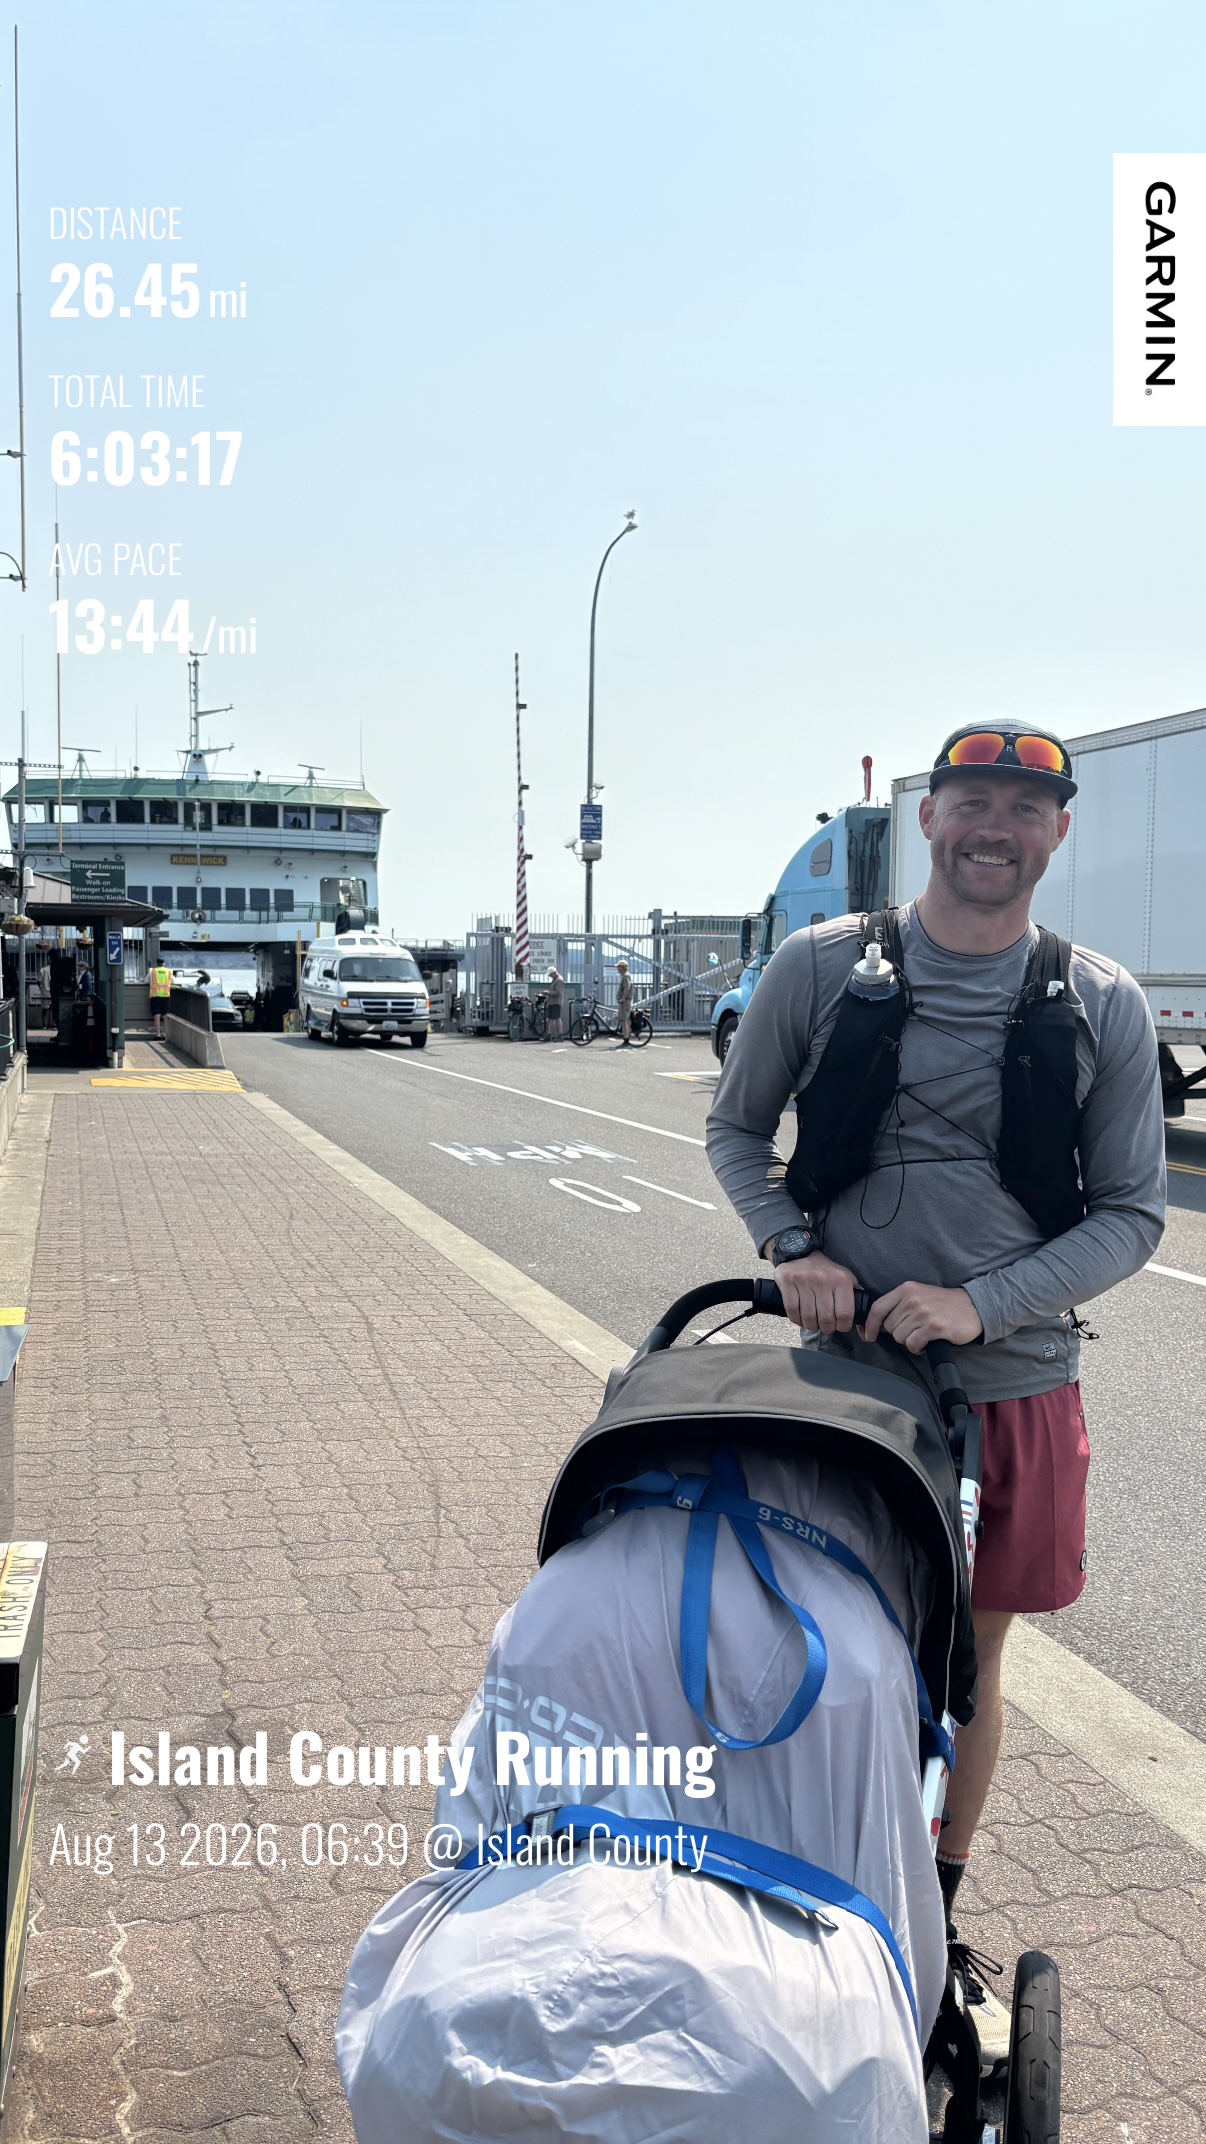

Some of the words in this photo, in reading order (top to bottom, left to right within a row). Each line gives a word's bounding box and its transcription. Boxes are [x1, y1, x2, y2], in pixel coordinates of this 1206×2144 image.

[72, 862, 98, 870] Terminal
[98, 863, 125, 871] Entrance
[72, 886, 101, 894] Passenger
[101, 887, 125, 895] Loading
[72, 893, 125, 901] Restrooms/Kiosks
